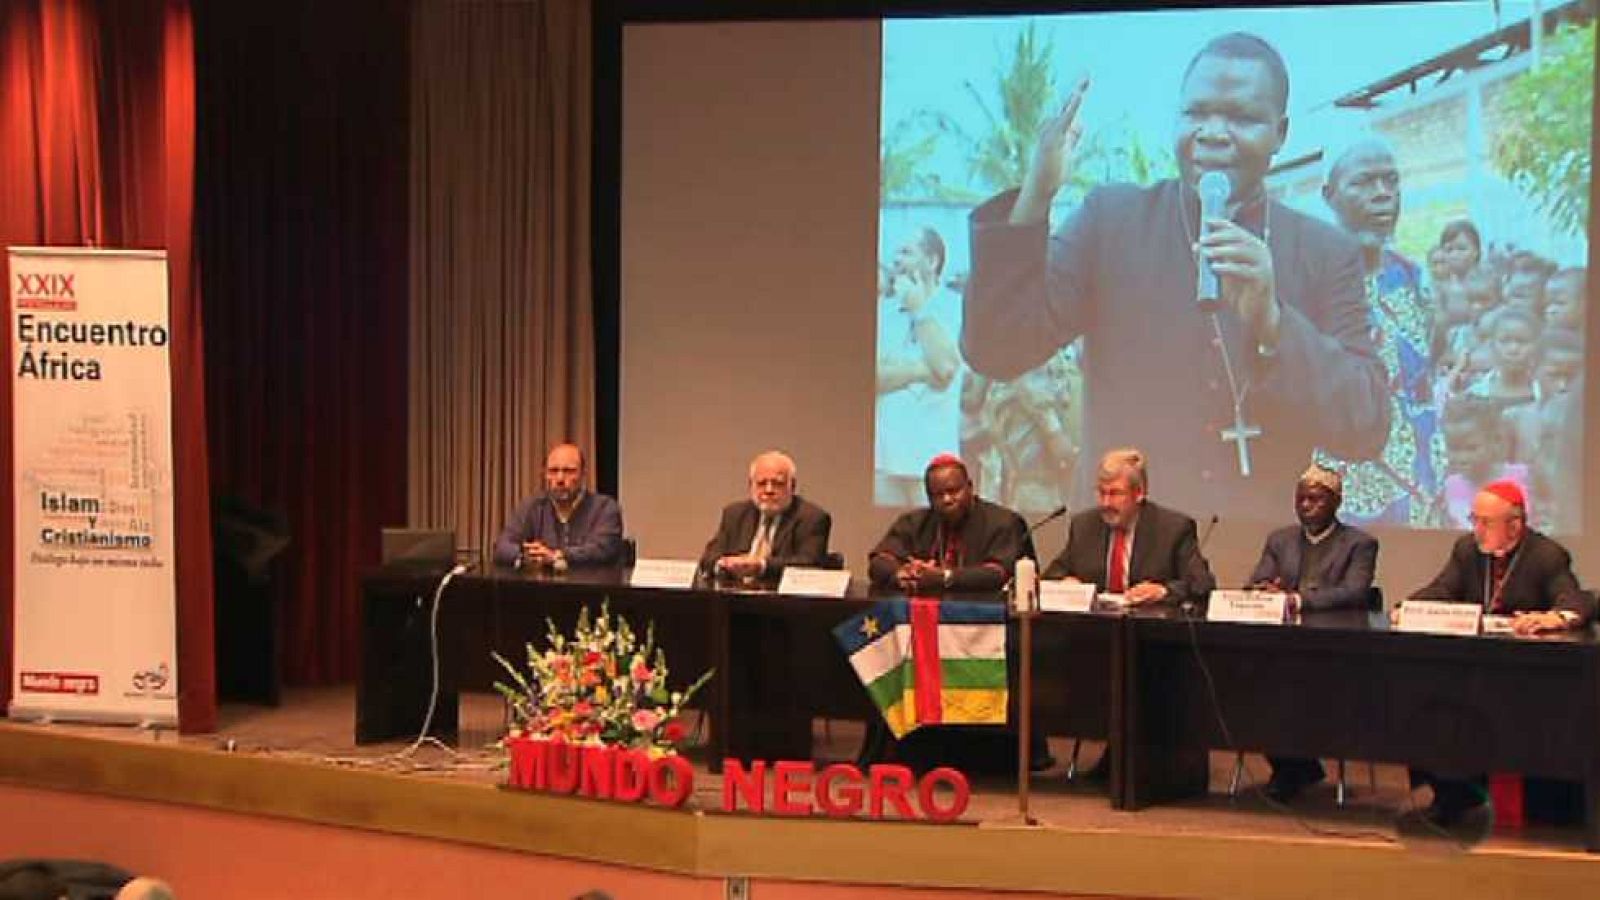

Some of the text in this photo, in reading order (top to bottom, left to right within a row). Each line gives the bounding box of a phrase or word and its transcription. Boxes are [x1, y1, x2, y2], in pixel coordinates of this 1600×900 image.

[17, 274, 75, 297] XXIX
[18, 314, 167, 347] Encuentro
[18, 344, 101, 380] África
[41, 491, 99, 513] Islam
[41, 528, 151, 547] Cristianismo
[508, 738, 971, 822] MUNDO NEGRO
